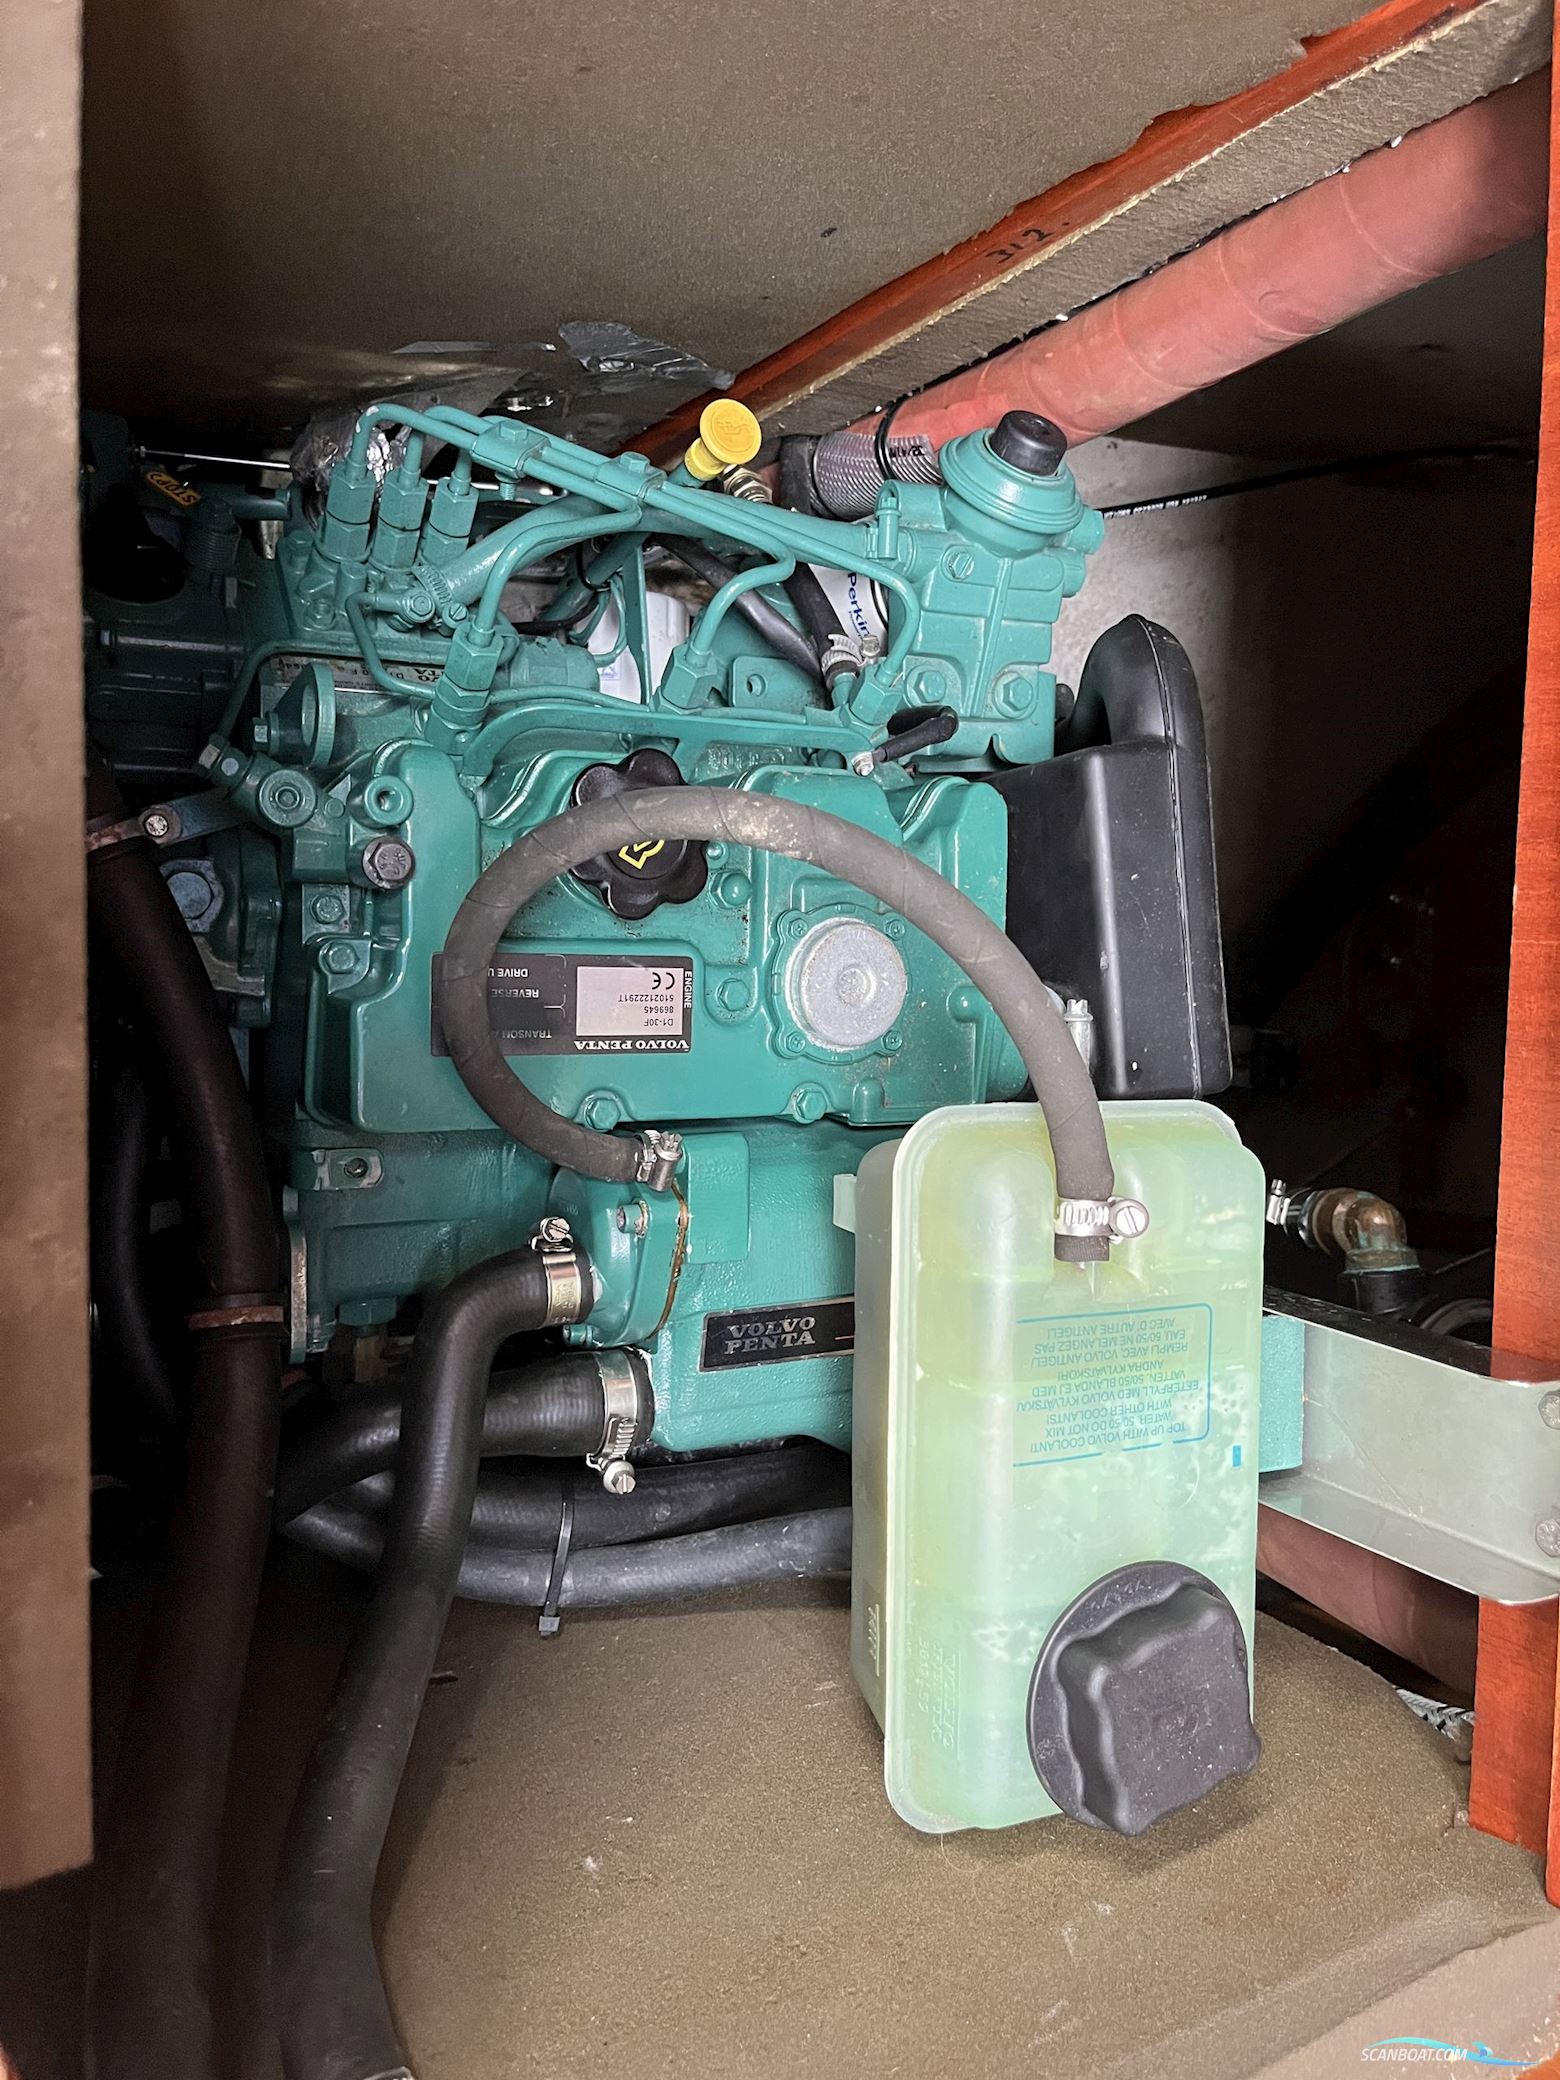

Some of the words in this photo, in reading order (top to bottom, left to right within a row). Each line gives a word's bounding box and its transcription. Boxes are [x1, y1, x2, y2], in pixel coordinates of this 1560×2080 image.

[848, 572, 870, 637] Perkin
[498, 968, 528, 977] DRIVE
[492, 989, 539, 997] REVERSE
[684, 970, 692, 1008] ENGINE
[619, 994, 674, 1002] 5102122291T
[644, 1018, 673, 1026] D1-30F
[574, 1040, 632, 1050] PENTA
[636, 1040, 689, 1049] VOLVO
[728, 1316, 816, 1338] VOLVO
[1099, 1321, 1136, 1335] AUTRE
[1150, 1318, 1175, 1331] AVEC
[724, 1331, 816, 1355] PENTA
[1119, 1335, 1134, 1346] NE
[1034, 1342, 1056, 1355] PAS
[1151, 1342, 1188, 1356] REMPLI
[1084, 1350, 1118, 1362] VOLVO
[1127, 1360, 1164, 1373] ANDRA
[1074, 1378, 1116, 1393] BLANDA
[1118, 1374, 1144, 1387] 50/50
[1032, 1385, 1057, 1398] MED
[1059, 1383, 1072, 1395] EJ
[1117, 1387, 1140, 1400] MED
[1143, 1380, 1200, 1396] EFTERFYLL
[1081, 1391, 1115, 1405] VOLVO
[1112, 1402, 1145, 1415] OTHER
[1147, 1399, 1172, 1411] WITH
[1045, 1426, 1065, 1439] MIX
[1067, 1423, 1089, 1436] NOT
[1091, 1421, 1107, 1433] DO
[1151, 1425, 1165, 1436] UP
[1166, 1422, 1185, 1433] TOP
[1088, 1431, 1120, 1446] VOLVO
[1123, 1427, 1149, 1441] WITH
